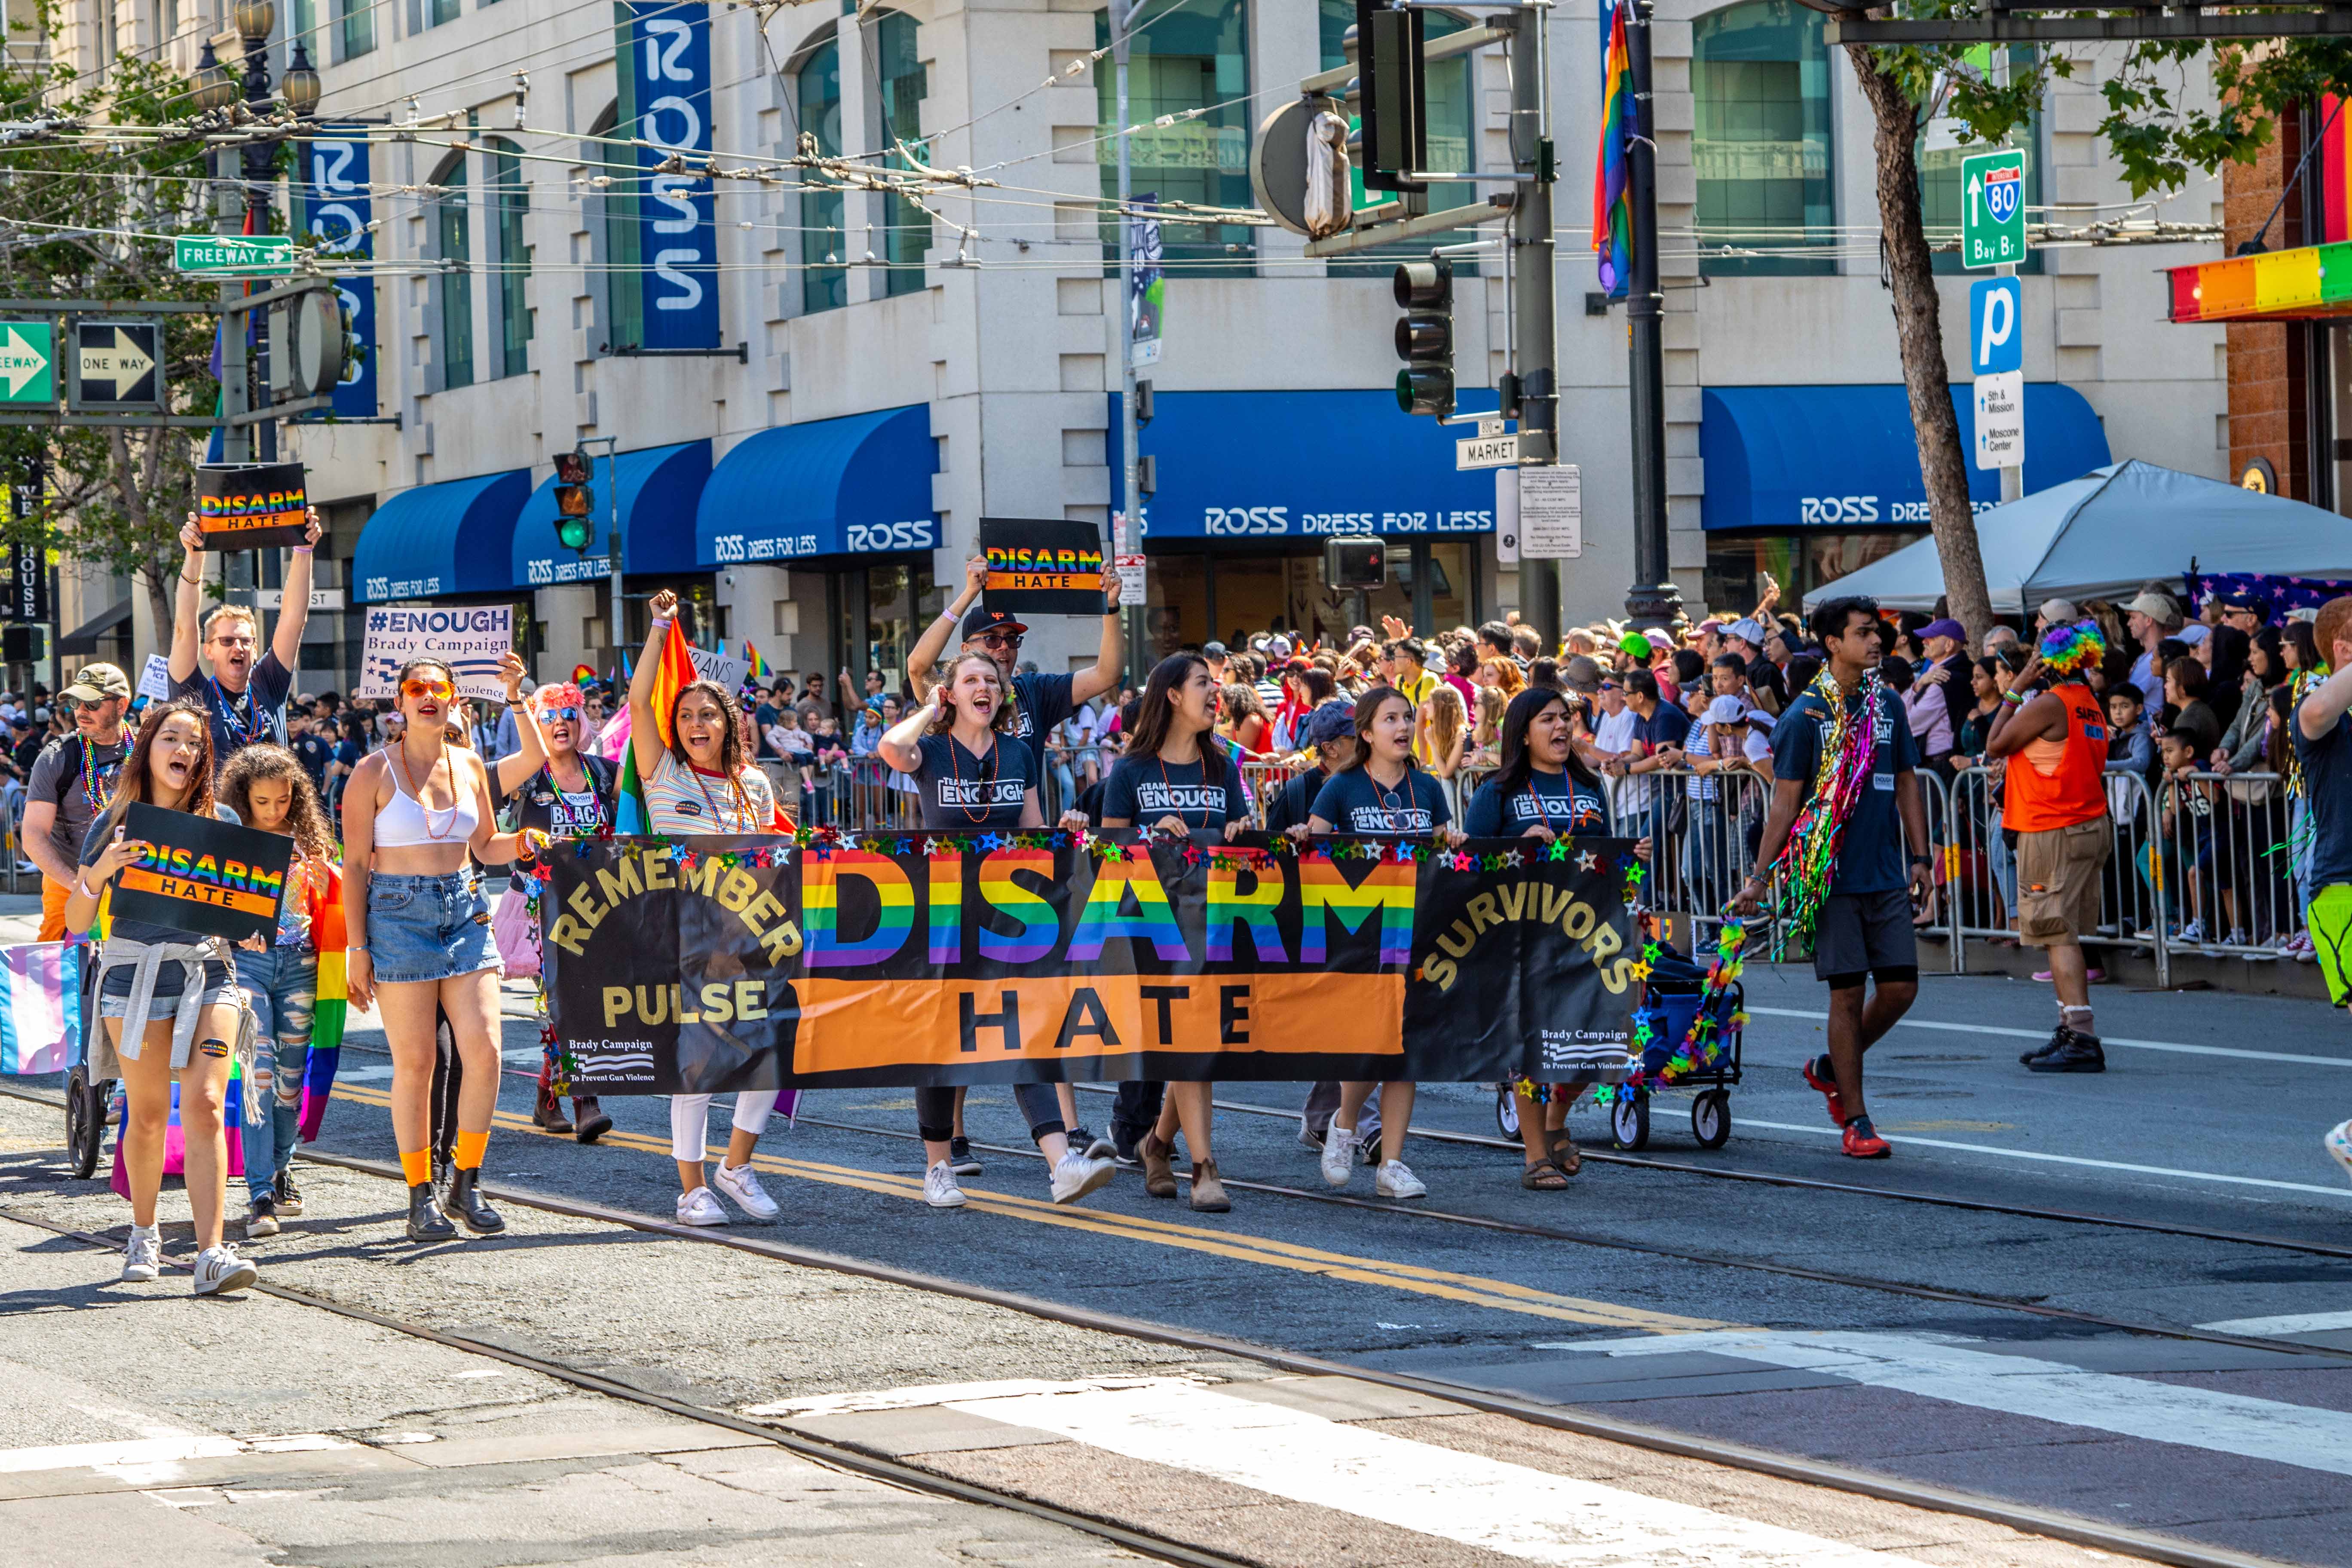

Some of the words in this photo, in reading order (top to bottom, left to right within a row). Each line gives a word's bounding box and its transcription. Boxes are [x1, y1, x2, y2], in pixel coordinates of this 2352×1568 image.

[645, 19, 702, 309] ROSS
[1992, 172, 2013, 180] INTERSTATE
[1991, 184, 2014, 213] 80
[184, 248, 257, 263] FREEWAY
[1975, 238, 1995, 260] Bay
[2001, 236, 2014, 256] Br
[83, 358, 109, 369] ONE
[119, 358, 146, 369] WAY
[1988, 390, 1998, 401] 5th
[2001, 389, 2006, 400] &
[1989, 401, 2015, 414] Mission
[1482, 423, 1492, 433] 800
[1989, 427, 2019, 439] Moscone
[1468, 442, 1514, 461] MARKET
[1990, 440, 2012, 452] Center
[201, 488, 304, 516] DISARM
[1802, 496, 1879, 524] ROSS
[1892, 502, 1929, 521] DRE
[228, 516, 279, 529] HATE
[1205, 506, 1288, 535] ROSS
[1302, 513, 1373, 533] DRESS
[1383, 512, 1427, 531] FOR
[1437, 511, 1491, 530] LESS
[848, 520, 934, 552] ROSS
[715, 535, 744, 561] ROSS
[748, 539, 775, 559] DRESS
[776, 537, 793, 555] FOR
[796, 535, 817, 554] LESS
[987, 547, 1102, 573] DISARM
[528, 559, 553, 583] ROSS
[555, 563, 577, 581] DRESS
[579, 560, 593, 579] FOR
[594, 558, 612, 576] LESS
[367, 577, 388, 600] ROSS
[390, 581, 409, 598] DRESS
[410, 579, 423, 597] FOR
[424, 577, 439, 594] LESS
[1014, 576, 1070, 588] HATE
[311, 594, 326, 605] ST
[369, 609, 508, 633] #ENOUGH
[368, 637, 417, 654] Brady
[425, 637, 508, 654] Campaign
[147, 663, 167, 673] Again
[155, 657, 168, 665] Dyk
[689, 650, 733, 683] RANS
[363, 685, 377, 695] To
[456, 686, 504, 699] Violence
[943, 777, 969, 787] TEAM
[1141, 782, 1168, 791] TEAM
[1142, 790, 1225, 808] ENOUGH
[1354, 806, 1380, 815] TEAM
[130, 838, 282, 898] DISARM
[161, 879, 233, 906] HATE
[548, 847, 803, 968] REMEMBER
[802, 845, 1417, 968] DISARM
[1423, 881, 1638, 994] SURVIVORS
[603, 980, 768, 1028] PULSE
[959, 985, 1251, 1052] HATE
[1541, 1030, 1571, 1041] Brady
[1575, 1030, 1628, 1041] Campaign
[569, 1039, 598, 1052] Brady
[602, 1039, 653, 1051] Campaign
